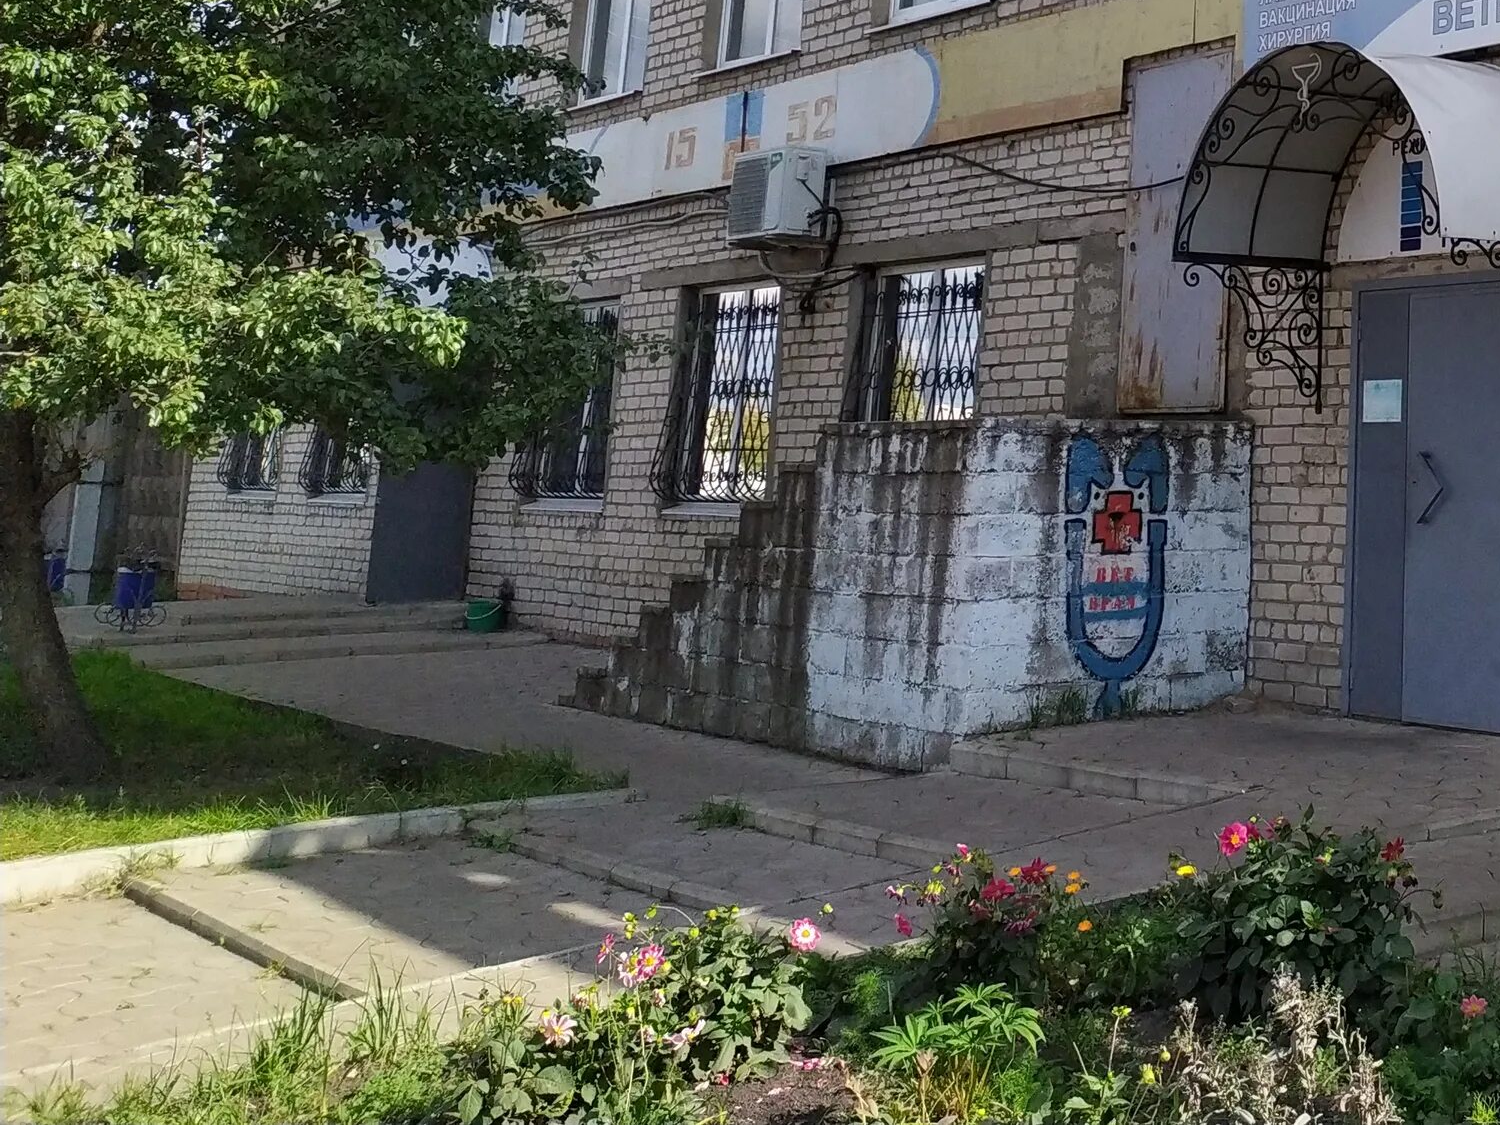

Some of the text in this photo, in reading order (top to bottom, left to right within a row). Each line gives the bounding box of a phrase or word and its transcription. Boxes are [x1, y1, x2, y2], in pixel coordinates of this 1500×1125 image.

[1258, 21, 1331, 52] ХИРУРГИЯ
[664, 95, 837, 170] 15 52
